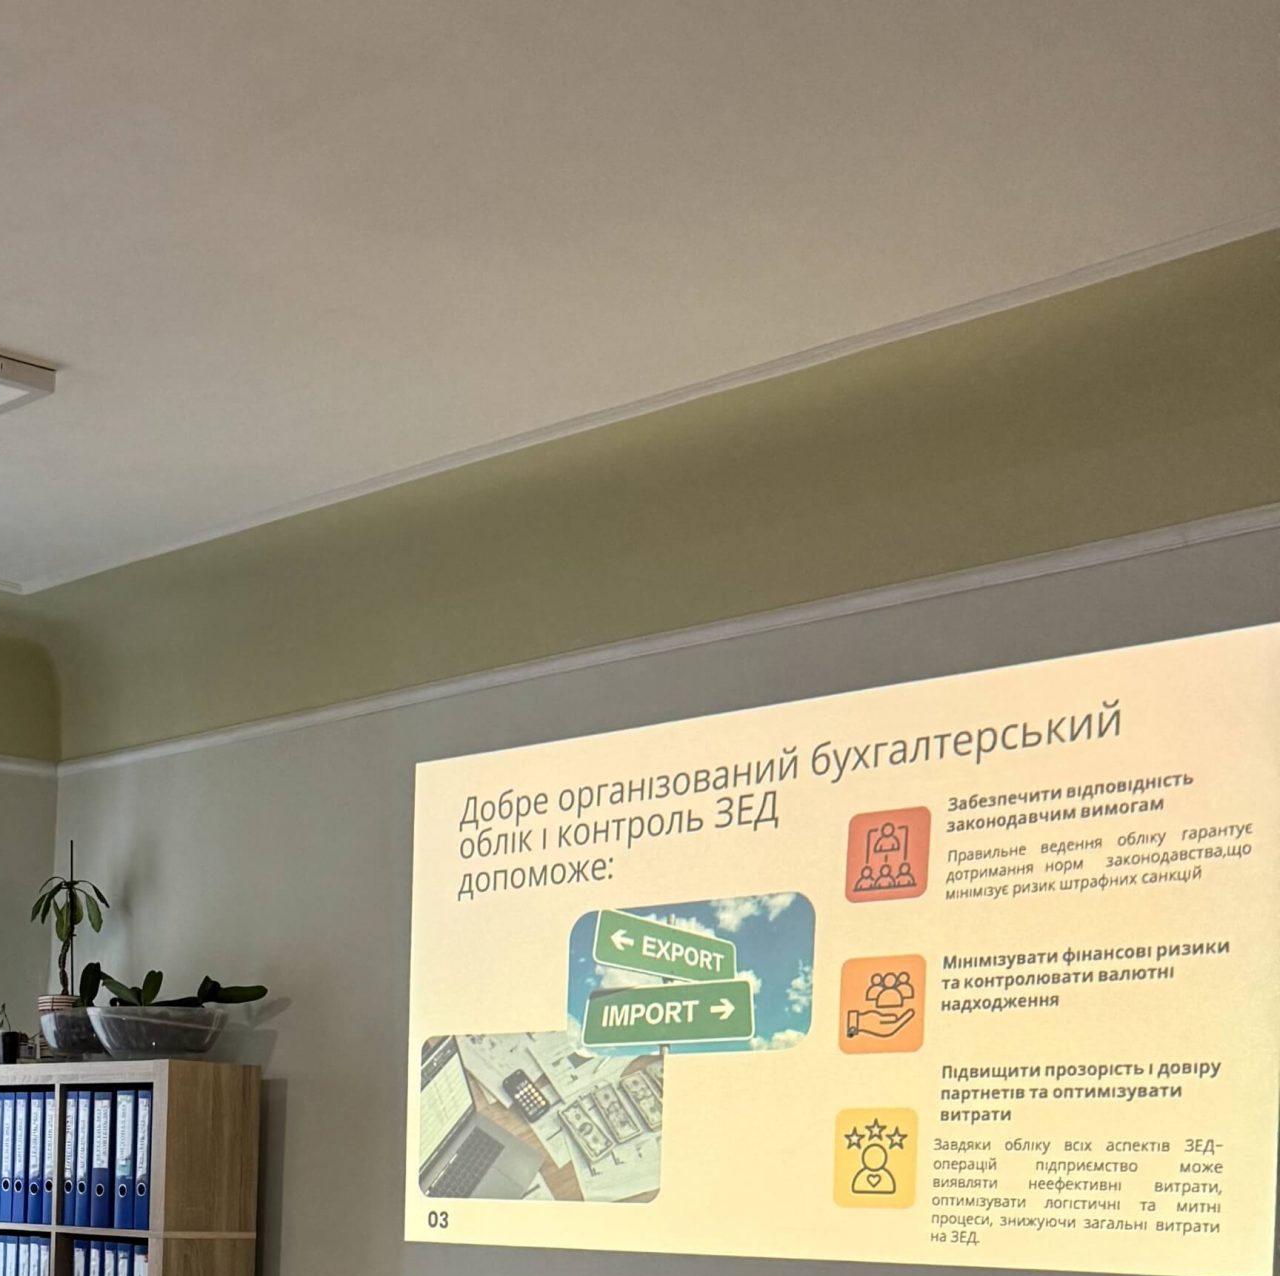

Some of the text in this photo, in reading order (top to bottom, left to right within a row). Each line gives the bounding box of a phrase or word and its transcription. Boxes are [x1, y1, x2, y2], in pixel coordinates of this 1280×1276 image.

[459, 699, 1121, 832] Добре організований бухгалтерський
[947, 773, 1194, 812] Забезпечити відповідність
[459, 790, 779, 860] облік і контроль ЗЕД
[946, 798, 1164, 833] законодавчим вимогам
[947, 822, 1253, 865] Правильне ведення обліку гарантує
[457, 856, 614, 901] допоможе:
[945, 865, 1202, 900] мінімізує ризик штрафних санкцій
[946, 862, 1033, 884] дотримання
[1045, 859, 1084, 876] норм
[642, 935, 725, 972] EXPORT
[943, 940, 1230, 971] Мінімізувати фінансові ризики
[942, 966, 1174, 990] та контролювати валютні
[601, 1000, 700, 1027] IMPORT
[941, 995, 1060, 1014] надходження
[942, 1065, 1041, 1081] Підвищити
[1045, 1063, 1144, 1080] прозорість
[1157, 1061, 1221, 1078] довіру
[940, 1084, 1182, 1103] партнетів та оптимізувати
[940, 1108, 1012, 1125] витрати
[933, 1138, 991, 1154] Завдяки
[1005, 1138, 1050, 1155] обліку
[1064, 1140, 1092, 1152] всіх
[1106, 1140, 1170, 1155] аспектів
[933, 1158, 1224, 1175] операцій підприємство може
[932, 1177, 1222, 1197] виявляти неефективні витрати,
[932, 1196, 1221, 1214] оптимізувати логістичні та митні
[428, 1210, 449, 1229] 03
[931, 1214, 1221, 1236] процеси, знижуючи загальні витрати
[930, 1232, 946, 1243] на
